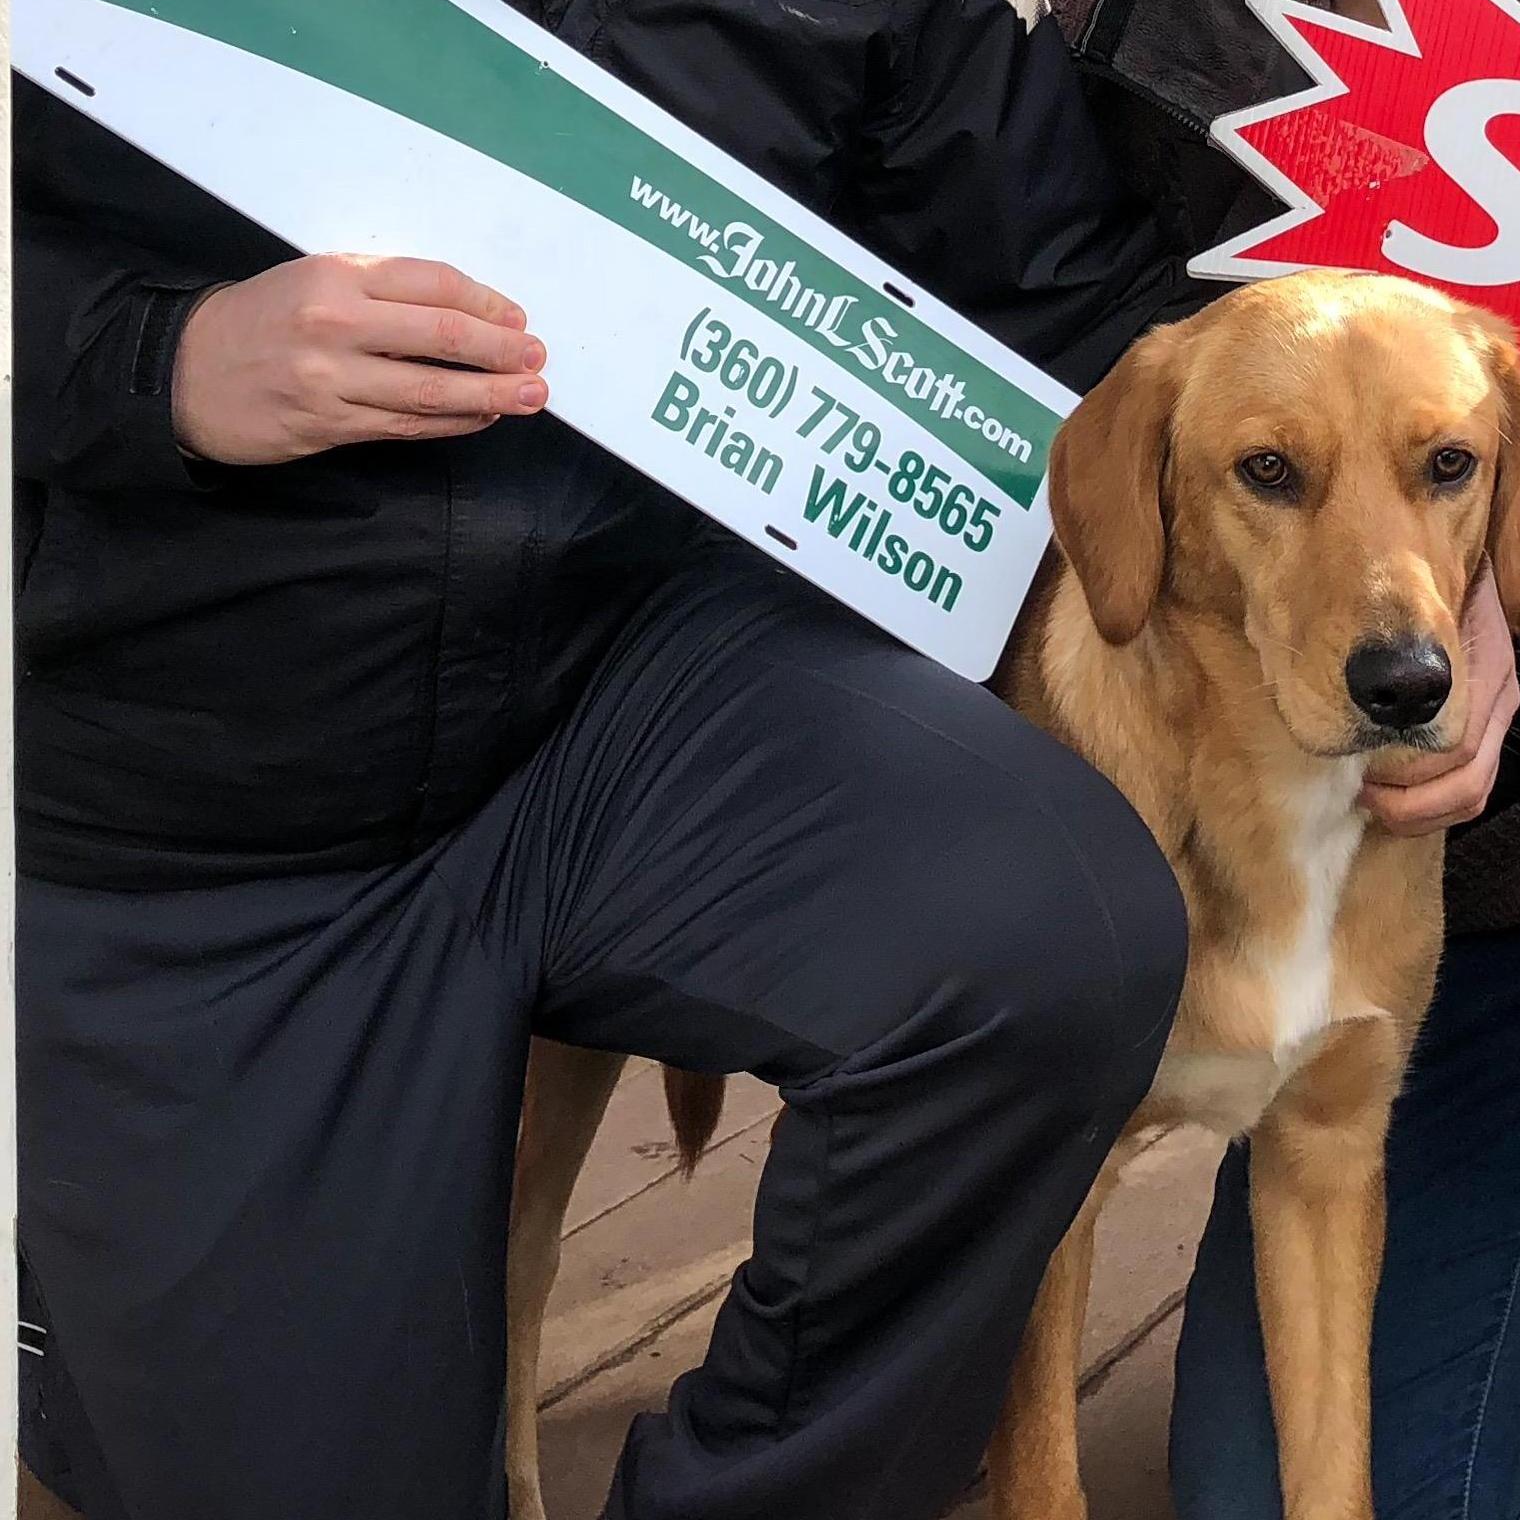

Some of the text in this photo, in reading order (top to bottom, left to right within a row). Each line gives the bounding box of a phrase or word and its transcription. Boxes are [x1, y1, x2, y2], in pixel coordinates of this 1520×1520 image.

[650, 371, 963, 613] Brian Wilson
[680, 307, 1001, 552] (360) 779-8565
